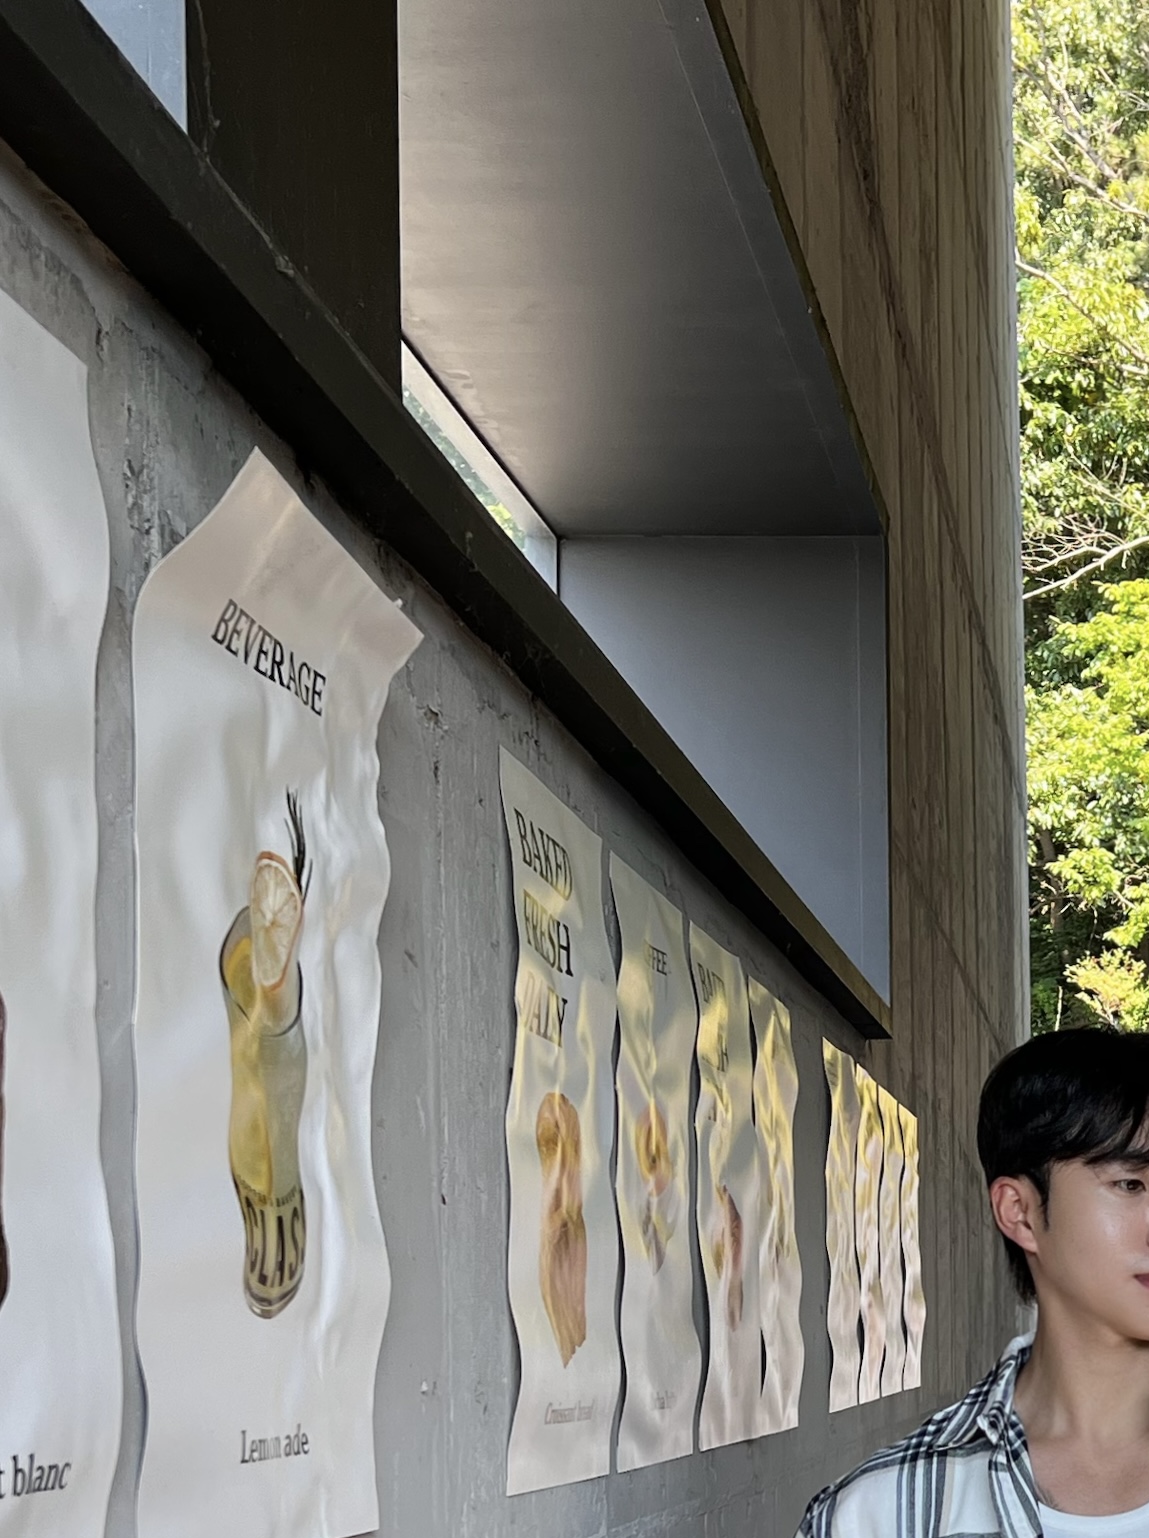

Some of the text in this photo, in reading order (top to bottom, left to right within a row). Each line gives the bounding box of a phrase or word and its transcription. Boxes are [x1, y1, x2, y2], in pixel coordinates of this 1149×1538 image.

[211, 598, 327, 717] BEVERAGE
[513, 806, 573, 901] BAKED
[523, 888, 574, 977] FRESH
[12, 1452, 72, 1497] blanc
[240, 1422, 310, 1465] Lemonade
